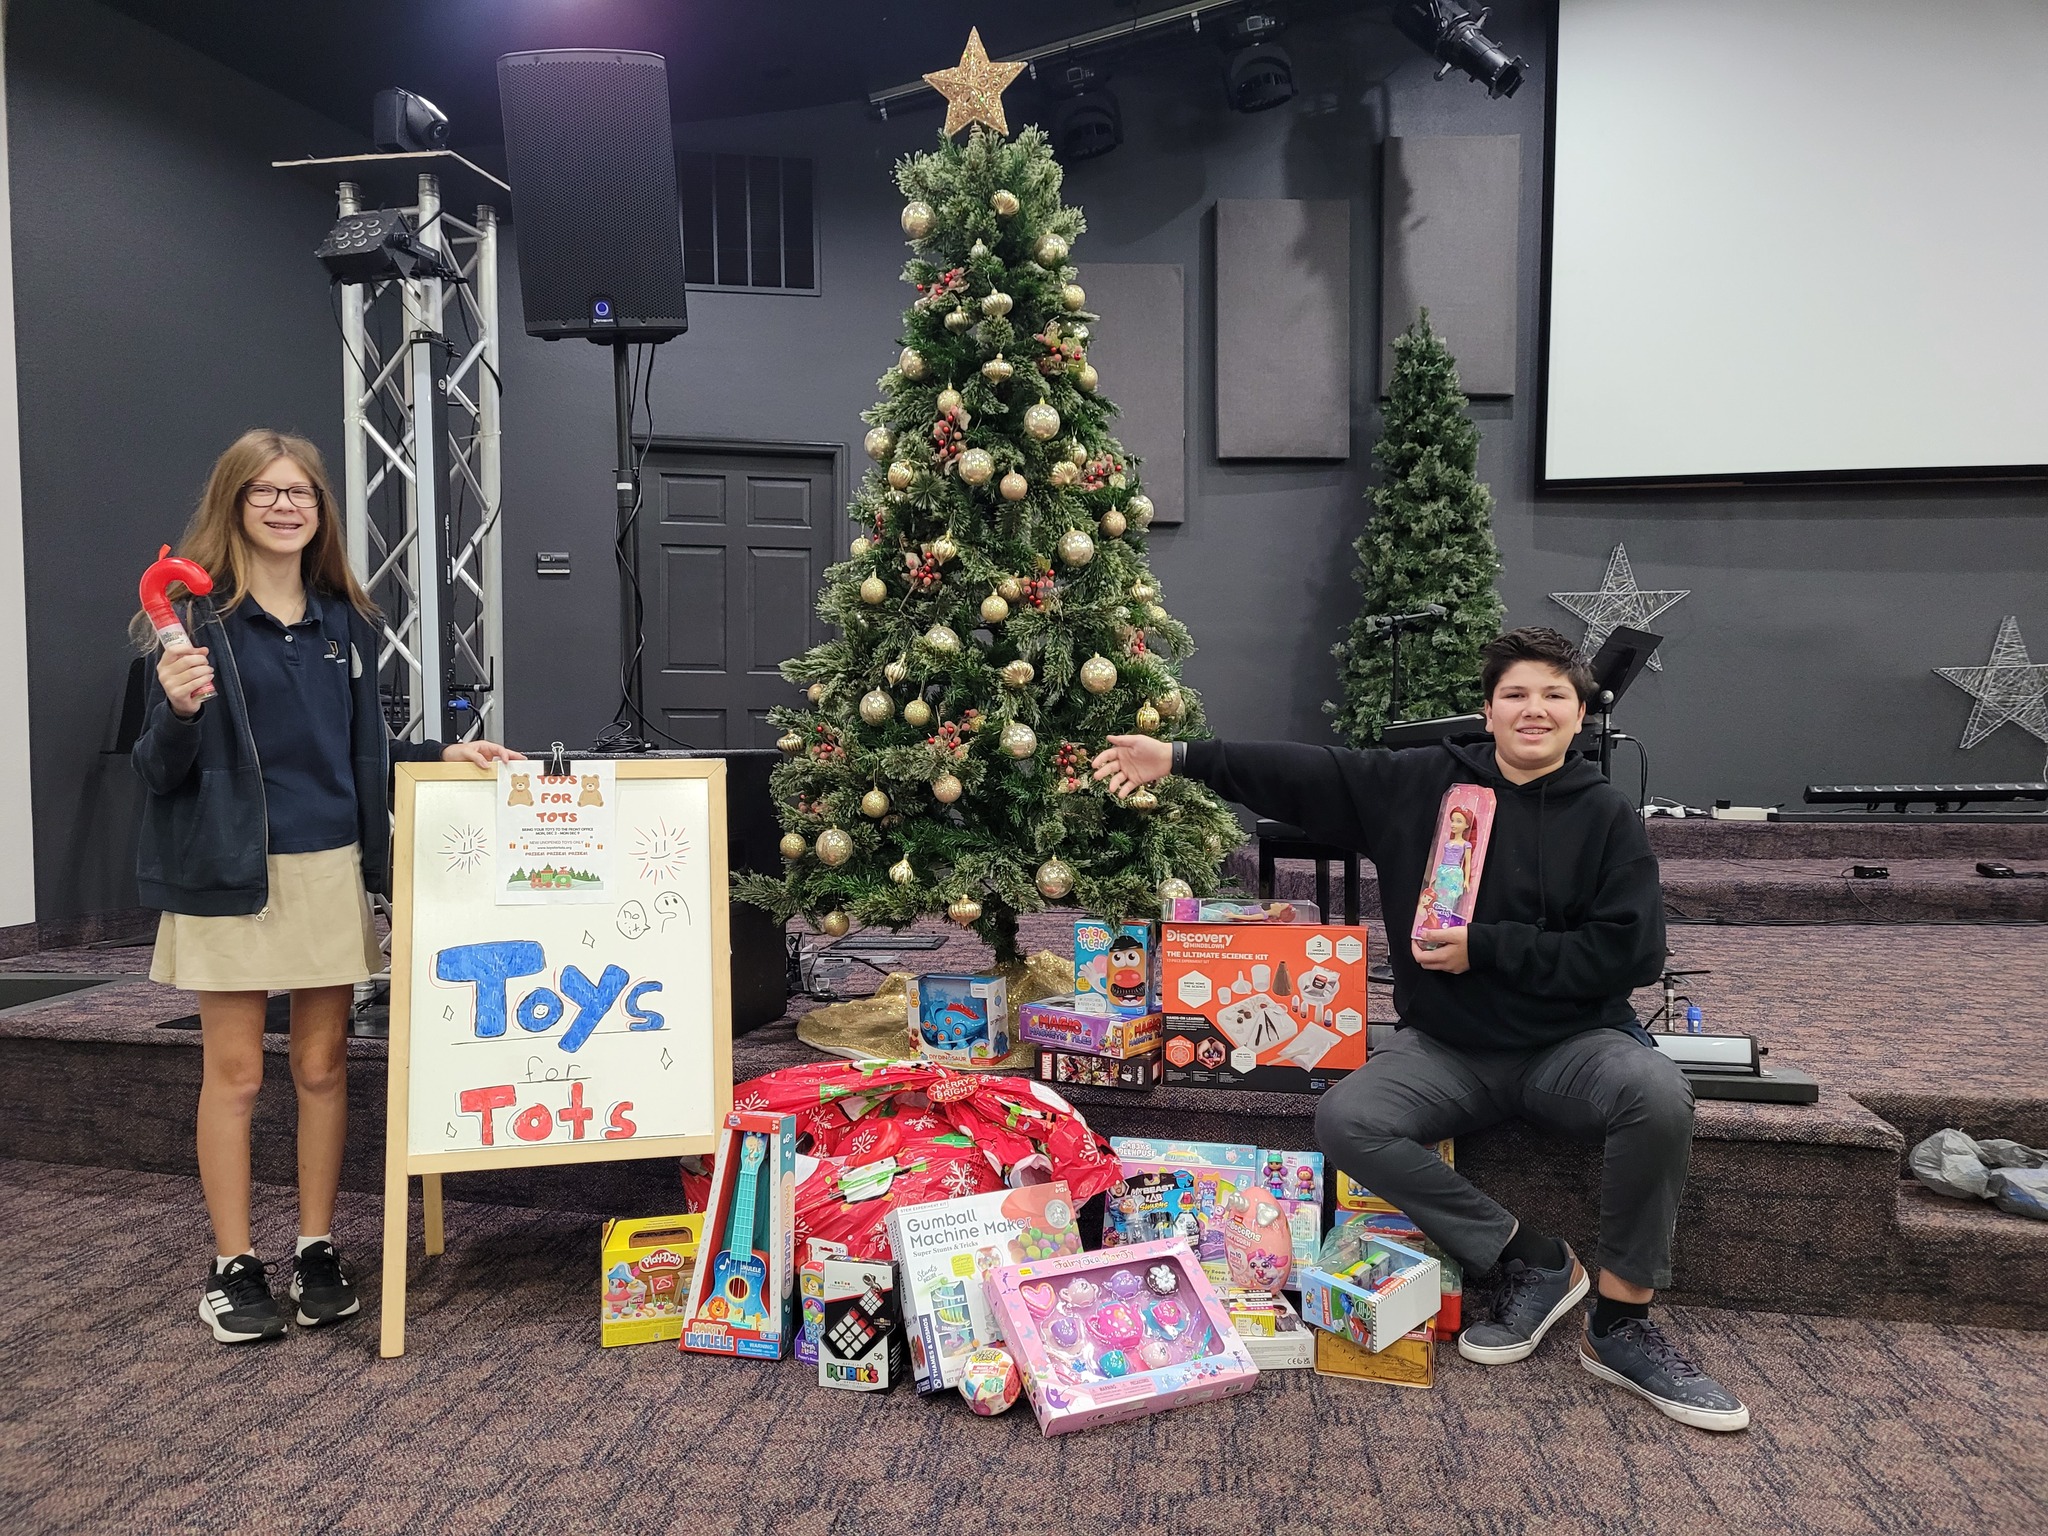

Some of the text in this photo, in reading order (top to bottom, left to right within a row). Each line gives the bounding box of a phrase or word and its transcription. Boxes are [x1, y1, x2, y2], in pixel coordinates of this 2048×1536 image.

[537, 775, 577, 785] TOYS
[541, 793, 572, 803] FOR
[536, 812, 577, 823] TOTS
[623, 910, 640, 919] no
[1079, 928, 1108, 940] Potato
[1166, 929, 1233, 946] Discovery
[1081, 939, 1106, 950] Head
[437, 940, 664, 1053] Toys
[1039, 1014, 1082, 1035] MAGIC
[1135, 1018, 1161, 1038] MAGIC
[1071, 1034, 1092, 1045] TILES
[526, 1056, 580, 1082] for
[1042, 1053, 1052, 1080] MARVEL
[936, 1078, 969, 1091] MERRY
[937, 1085, 974, 1098] BRIGHT
[460, 1082, 636, 1146] Tots
[1146, 1194, 1163, 1203] LAB
[907, 1208, 977, 1233] Gumball
[910, 1216, 1032, 1249] Machine Maker
[889, 1223, 899, 1261] Machin
[892, 1220, 905, 1267] Gumball
[960, 1241, 978, 1249] Tricks
[642, 1252, 681, 1268] Play-Doh
[784, 1230, 792, 1289] UKULELE
[1053, 1258, 1081, 1269] Fairy
[1082, 1256, 1099, 1266] Tea
[917, 1265, 938, 1281] Stunts
[693, 1322, 728, 1335] PARTY
[923, 1317, 932, 1341] KOSMOS
[685, 1332, 734, 1351] UKULELE
[929, 1350, 939, 1378] THAMES
[826, 1363, 879, 1383] RUBIK'S
